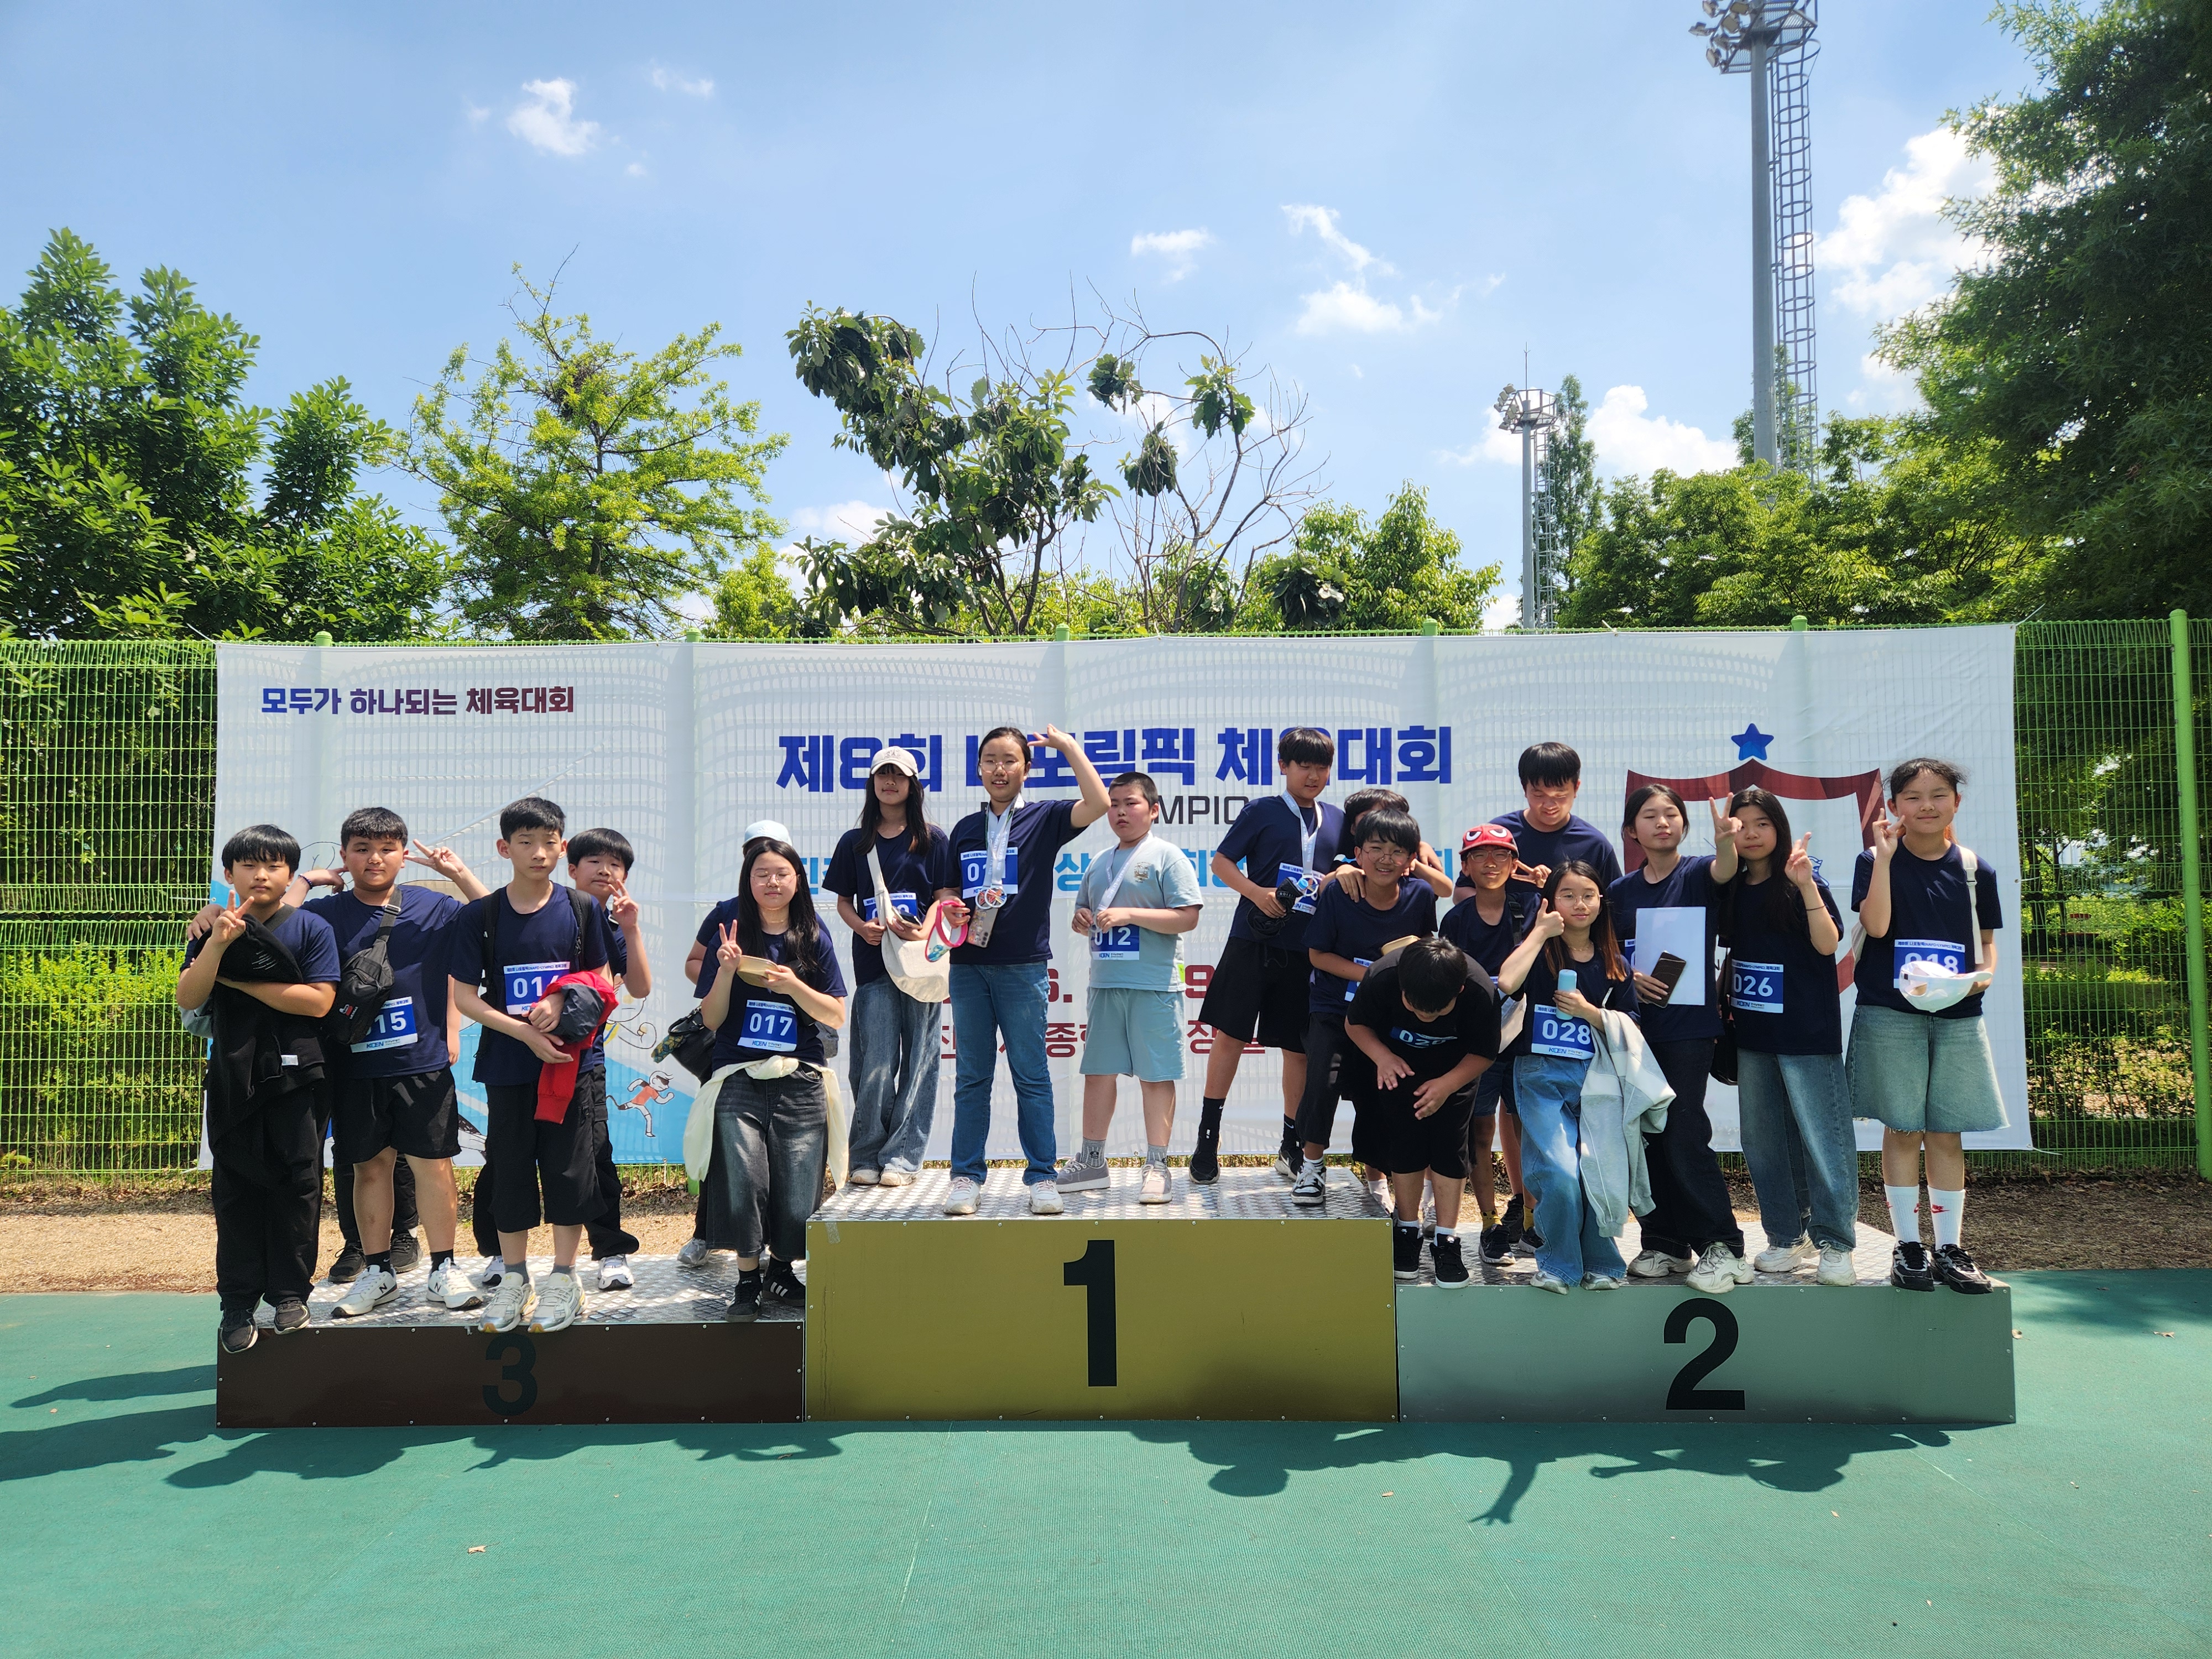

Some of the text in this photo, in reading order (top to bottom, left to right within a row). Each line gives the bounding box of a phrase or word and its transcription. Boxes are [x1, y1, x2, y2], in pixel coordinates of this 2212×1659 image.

[262, 686, 573, 715] 모두가 하나되는 체육대회
[775, 733, 942, 792] 제8회
[1215, 725, 1452, 786] 체대회
[1094, 927, 1131, 946] 012
[513, 975, 559, 998] 01
[1734, 973, 1773, 997] 026
[367, 1011, 406, 1035] 15
[749, 1013, 792, 1036] 017
[1542, 1019, 1591, 1045] 028
[1063, 1239, 1117, 1387] 1
[1663, 1297, 1745, 1411] 2
[482, 1333, 538, 1416] 3
